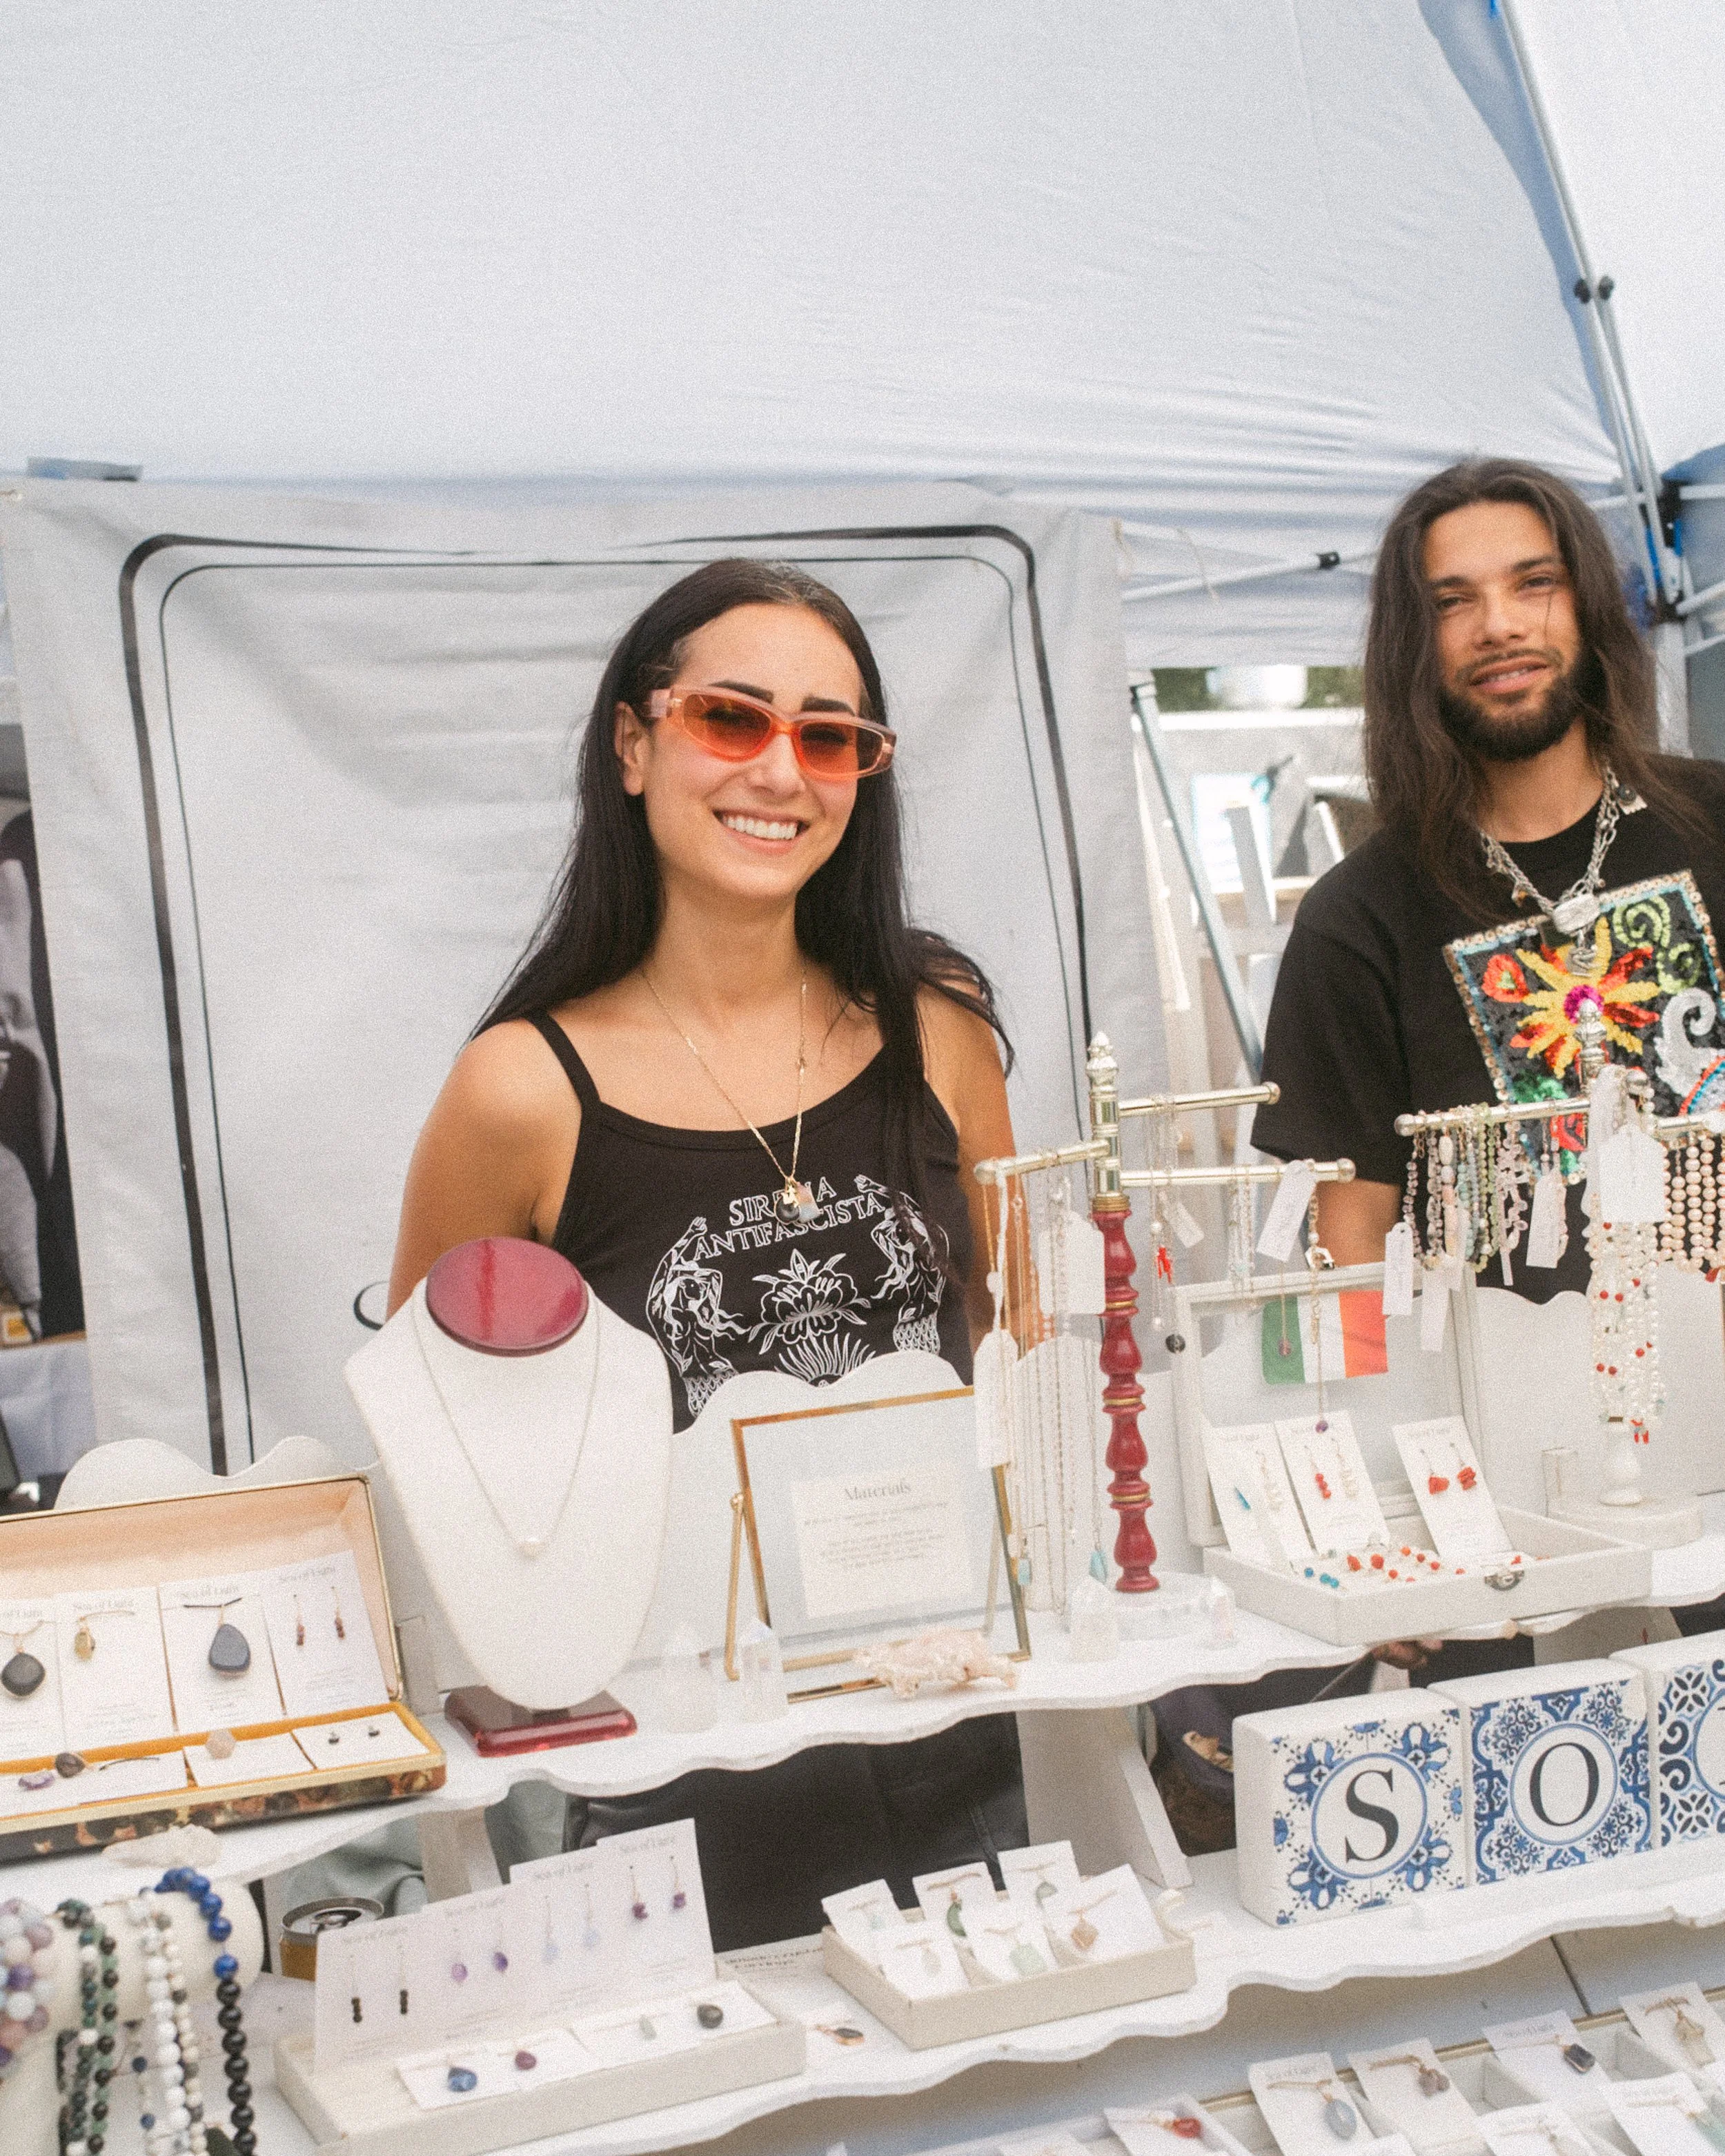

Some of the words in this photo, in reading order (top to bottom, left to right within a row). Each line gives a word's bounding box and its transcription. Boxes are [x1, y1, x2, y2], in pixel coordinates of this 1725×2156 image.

[729, 1176, 837, 1226] SIRA
[845, 1479, 911, 1500] Materials
[1344, 1769, 1400, 1863] S
[1529, 1742, 1600, 1827] O
